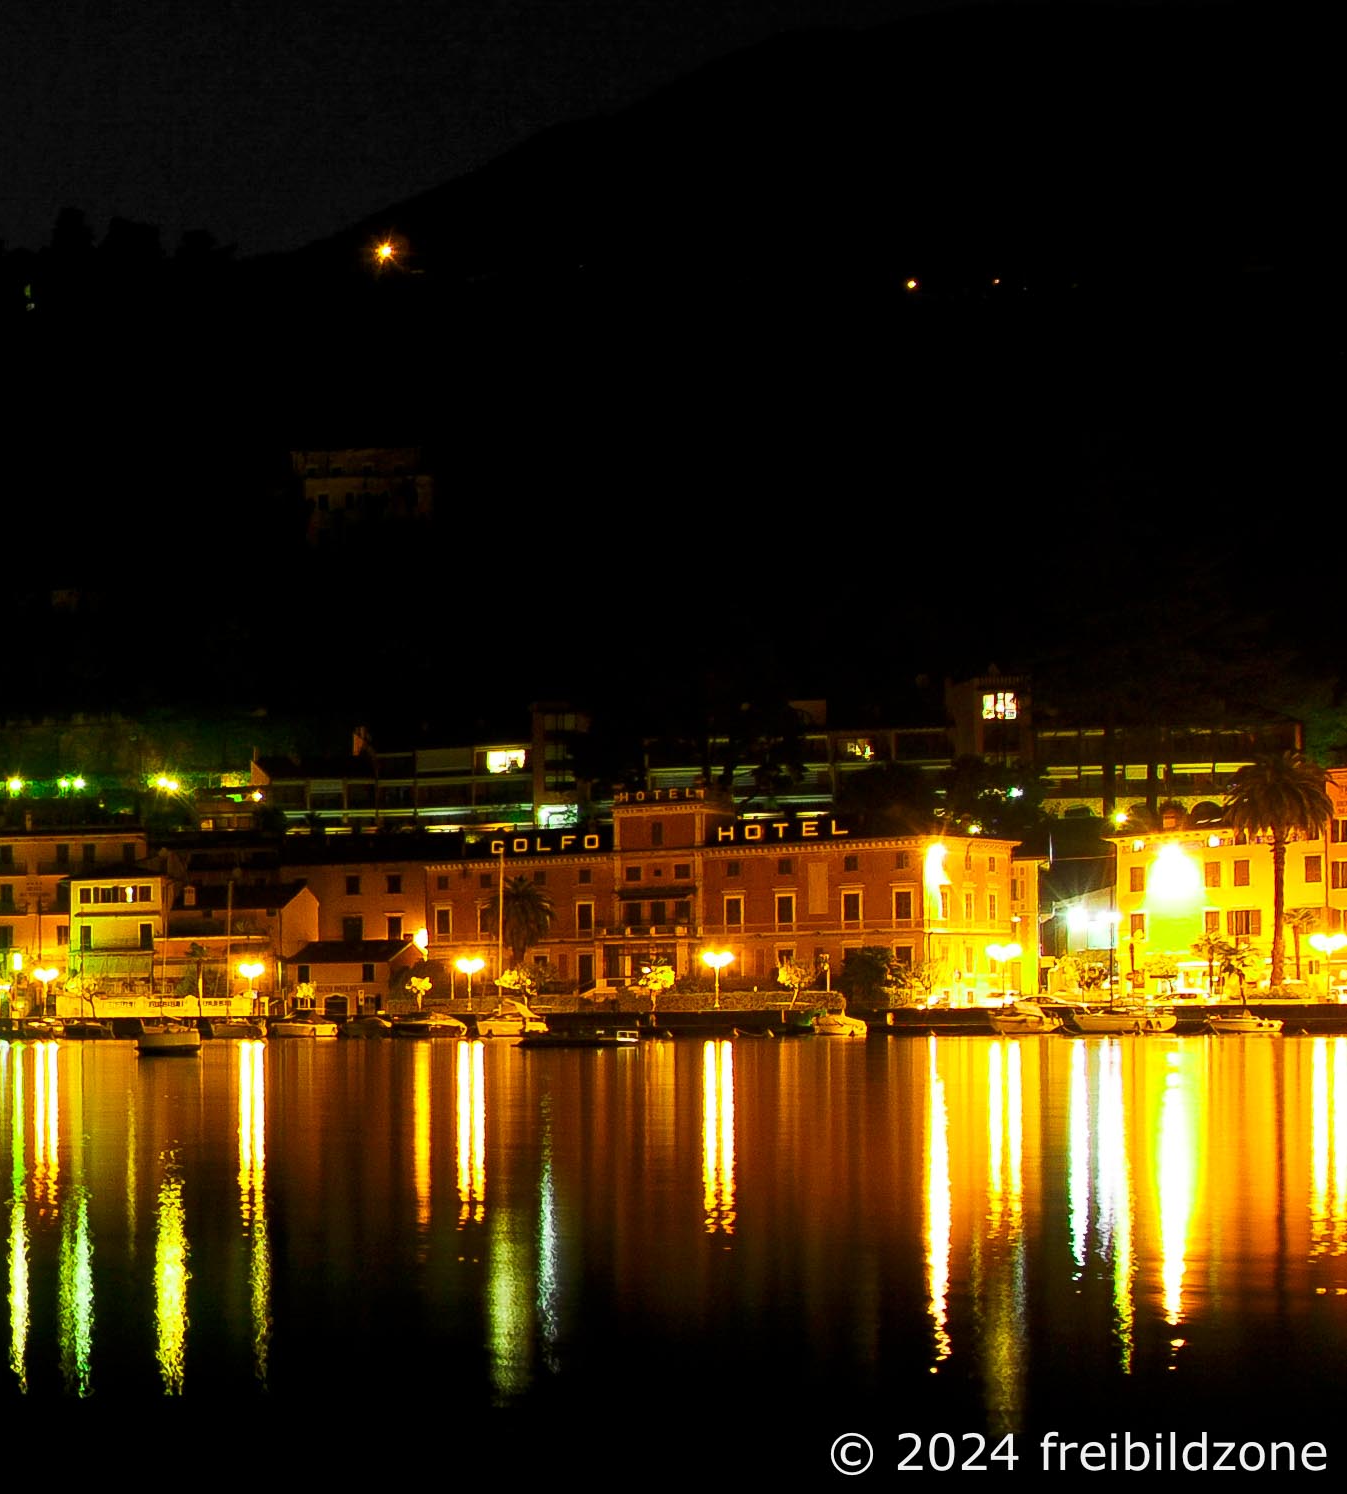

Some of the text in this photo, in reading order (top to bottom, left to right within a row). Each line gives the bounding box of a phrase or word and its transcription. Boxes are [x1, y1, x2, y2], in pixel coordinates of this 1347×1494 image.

[619, 787, 694, 801] HOTEL
[718, 819, 848, 841] HOTEL
[491, 834, 599, 854] GOLFO
